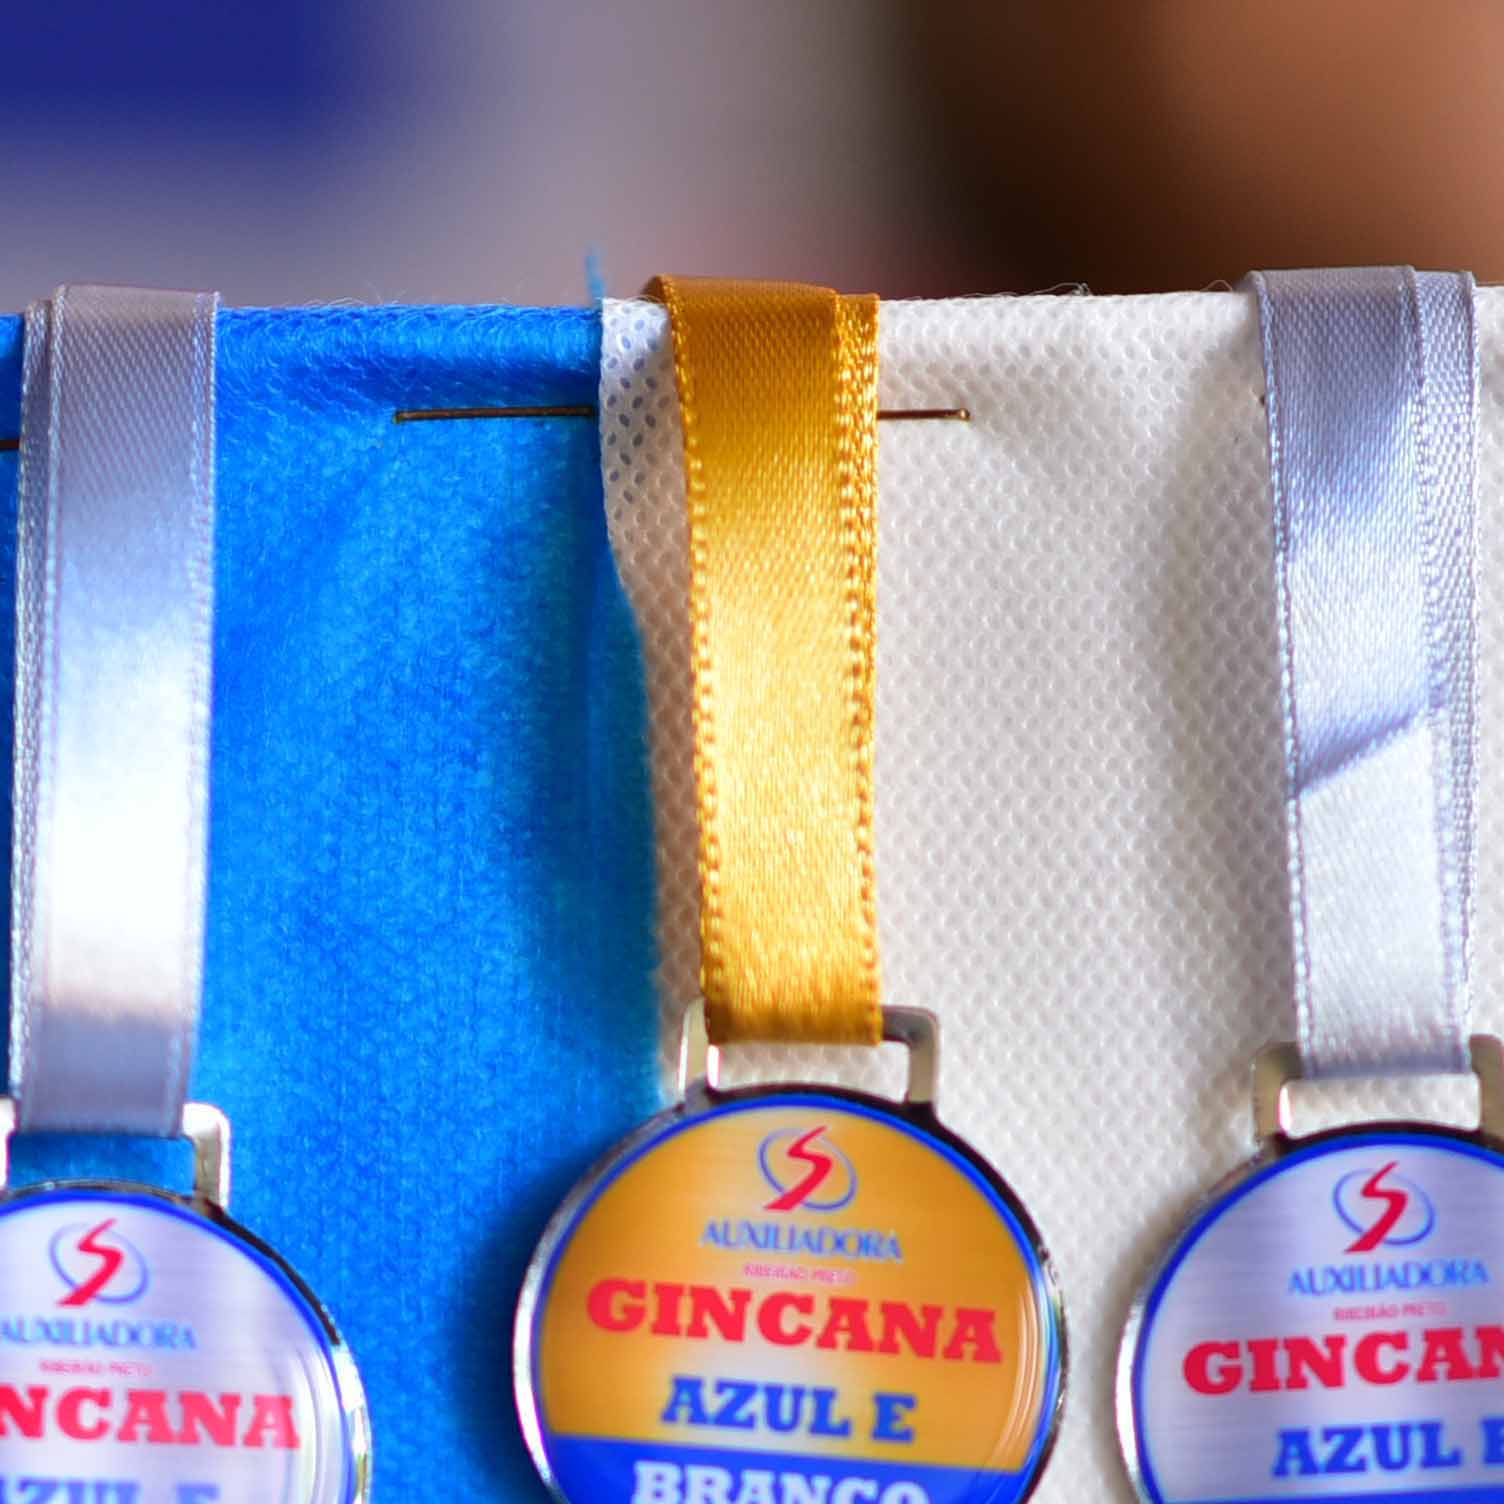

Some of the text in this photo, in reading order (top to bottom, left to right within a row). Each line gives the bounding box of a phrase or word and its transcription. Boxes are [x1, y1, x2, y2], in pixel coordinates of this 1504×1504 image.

[700, 1220, 903, 1261] AUXILIADORA
[1287, 1258, 1489, 1295] AUXILIADORA
[585, 1278, 1002, 1364] GINCANA
[660, 1375, 916, 1442] AZUL E
[1271, 1418, 1461, 1478] AZUL
